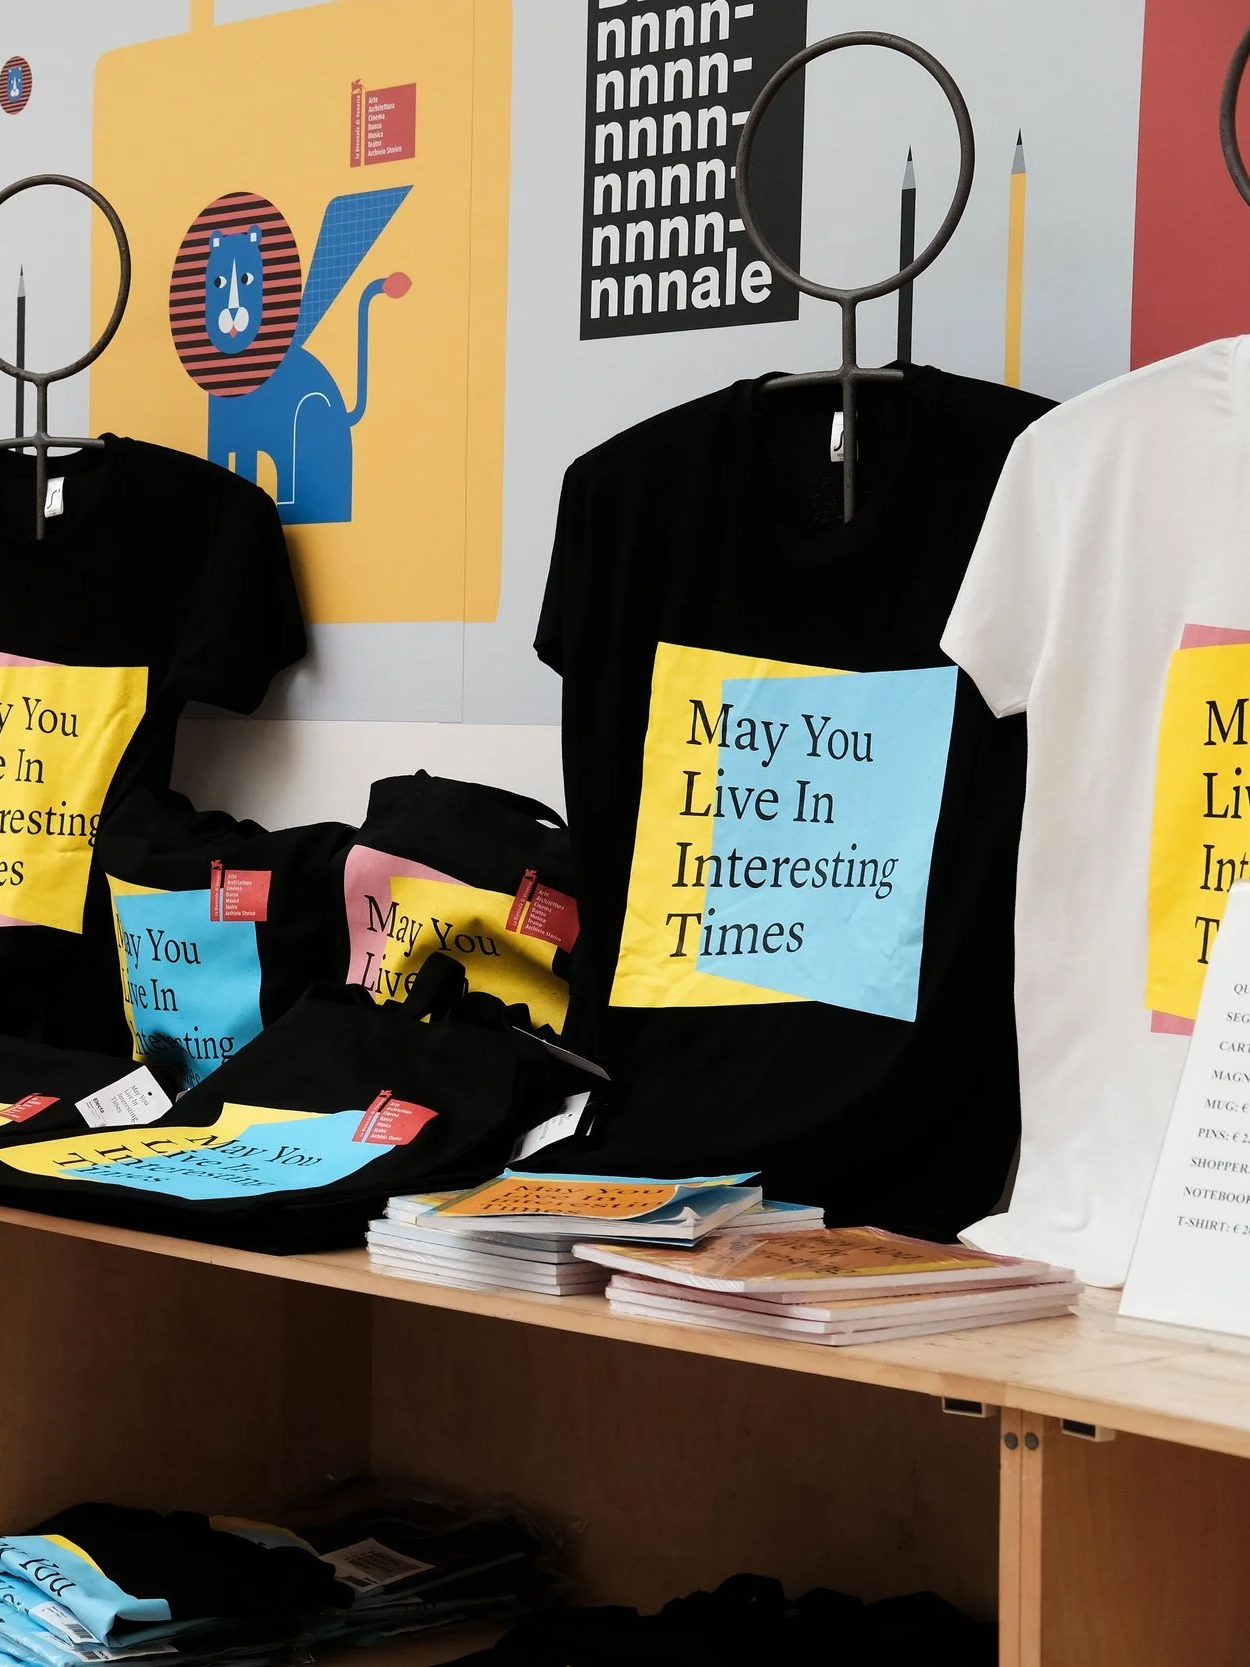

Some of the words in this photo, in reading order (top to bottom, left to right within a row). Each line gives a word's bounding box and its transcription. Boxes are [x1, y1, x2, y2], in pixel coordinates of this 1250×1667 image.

[597, 0, 754, 61] nnnn-
[596, 52, 752, 113] nnnn-
[595, 104, 750, 164] nnnn-
[590, 247, 772, 319] nnnale
[22, 696, 78, 738] You
[686, 698, 789, 768] May
[801, 713, 874, 762] You
[15, 748, 44, 784] In
[680, 768, 779, 820] Live
[792, 780, 834, 824] In
[672, 842, 900, 900] Interesting
[364, 894, 423, 957] May
[431, 917, 500, 956] You
[666, 908, 805, 958] Times
[146, 928, 201, 965] You
[362, 951, 420, 998] Live
[150, 978, 178, 1012] In
[93, 1098, 105, 1114] Electa
[111, 1096, 122, 1113] Times
[117, 1093, 139, 1123] Interesting
[1205, 1098, 1238, 1112] MUG:
[185, 1134, 268, 1159] May
[265, 1145, 323, 1167] You
[1198, 1128, 1229, 1140] PINS:
[1232, 1133, 1240, 1142] €
[53, 1152, 170, 1183] Times
[95, 1144, 275, 1188] Interesting
[141, 1138, 222, 1167] Live
[223, 1162, 259, 1174] In
[1177, 1216, 1230, 1232] T-SHIRT:
[1233, 1223, 1240, 1234] €
